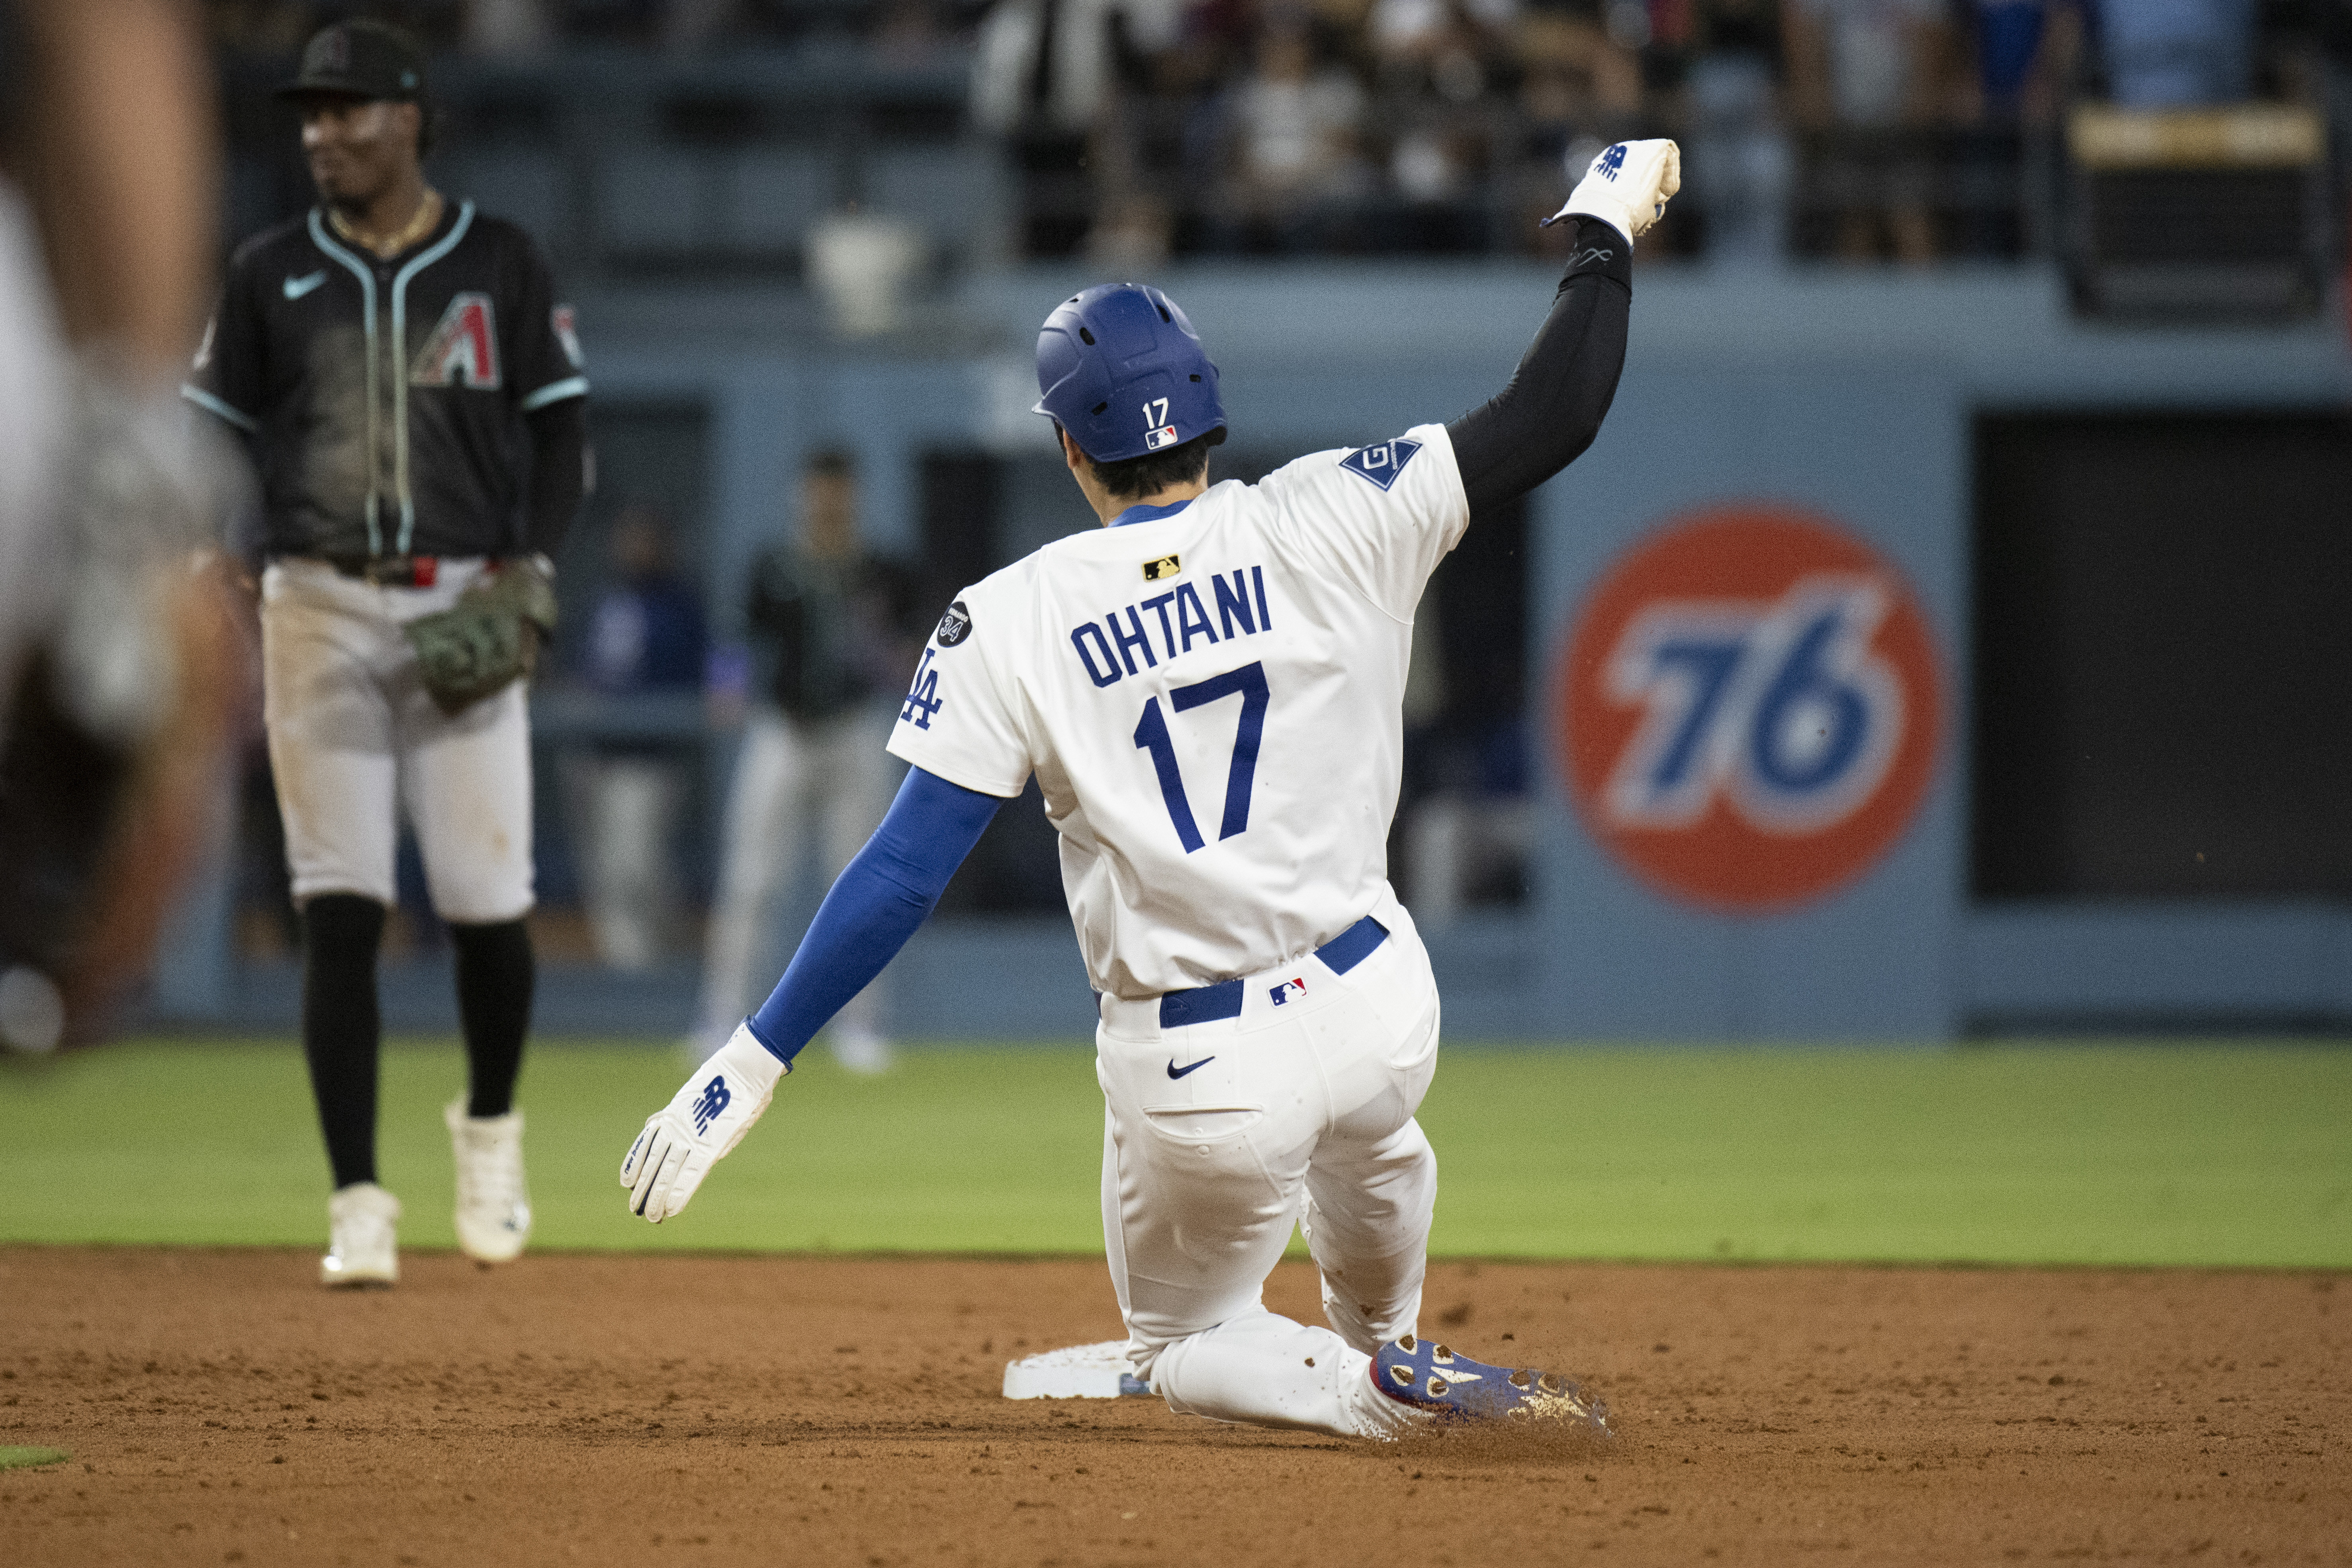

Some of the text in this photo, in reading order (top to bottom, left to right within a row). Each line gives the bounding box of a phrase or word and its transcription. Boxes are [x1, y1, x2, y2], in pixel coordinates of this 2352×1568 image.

[1142, 397, 1168, 429] 17
[940, 616, 963, 642] 34
[1070, 565, 1272, 688] OHTANI
[900, 647, 943, 731] LA
[1609, 577, 1904, 830] 76
[1133, 660, 1270, 854] 17
